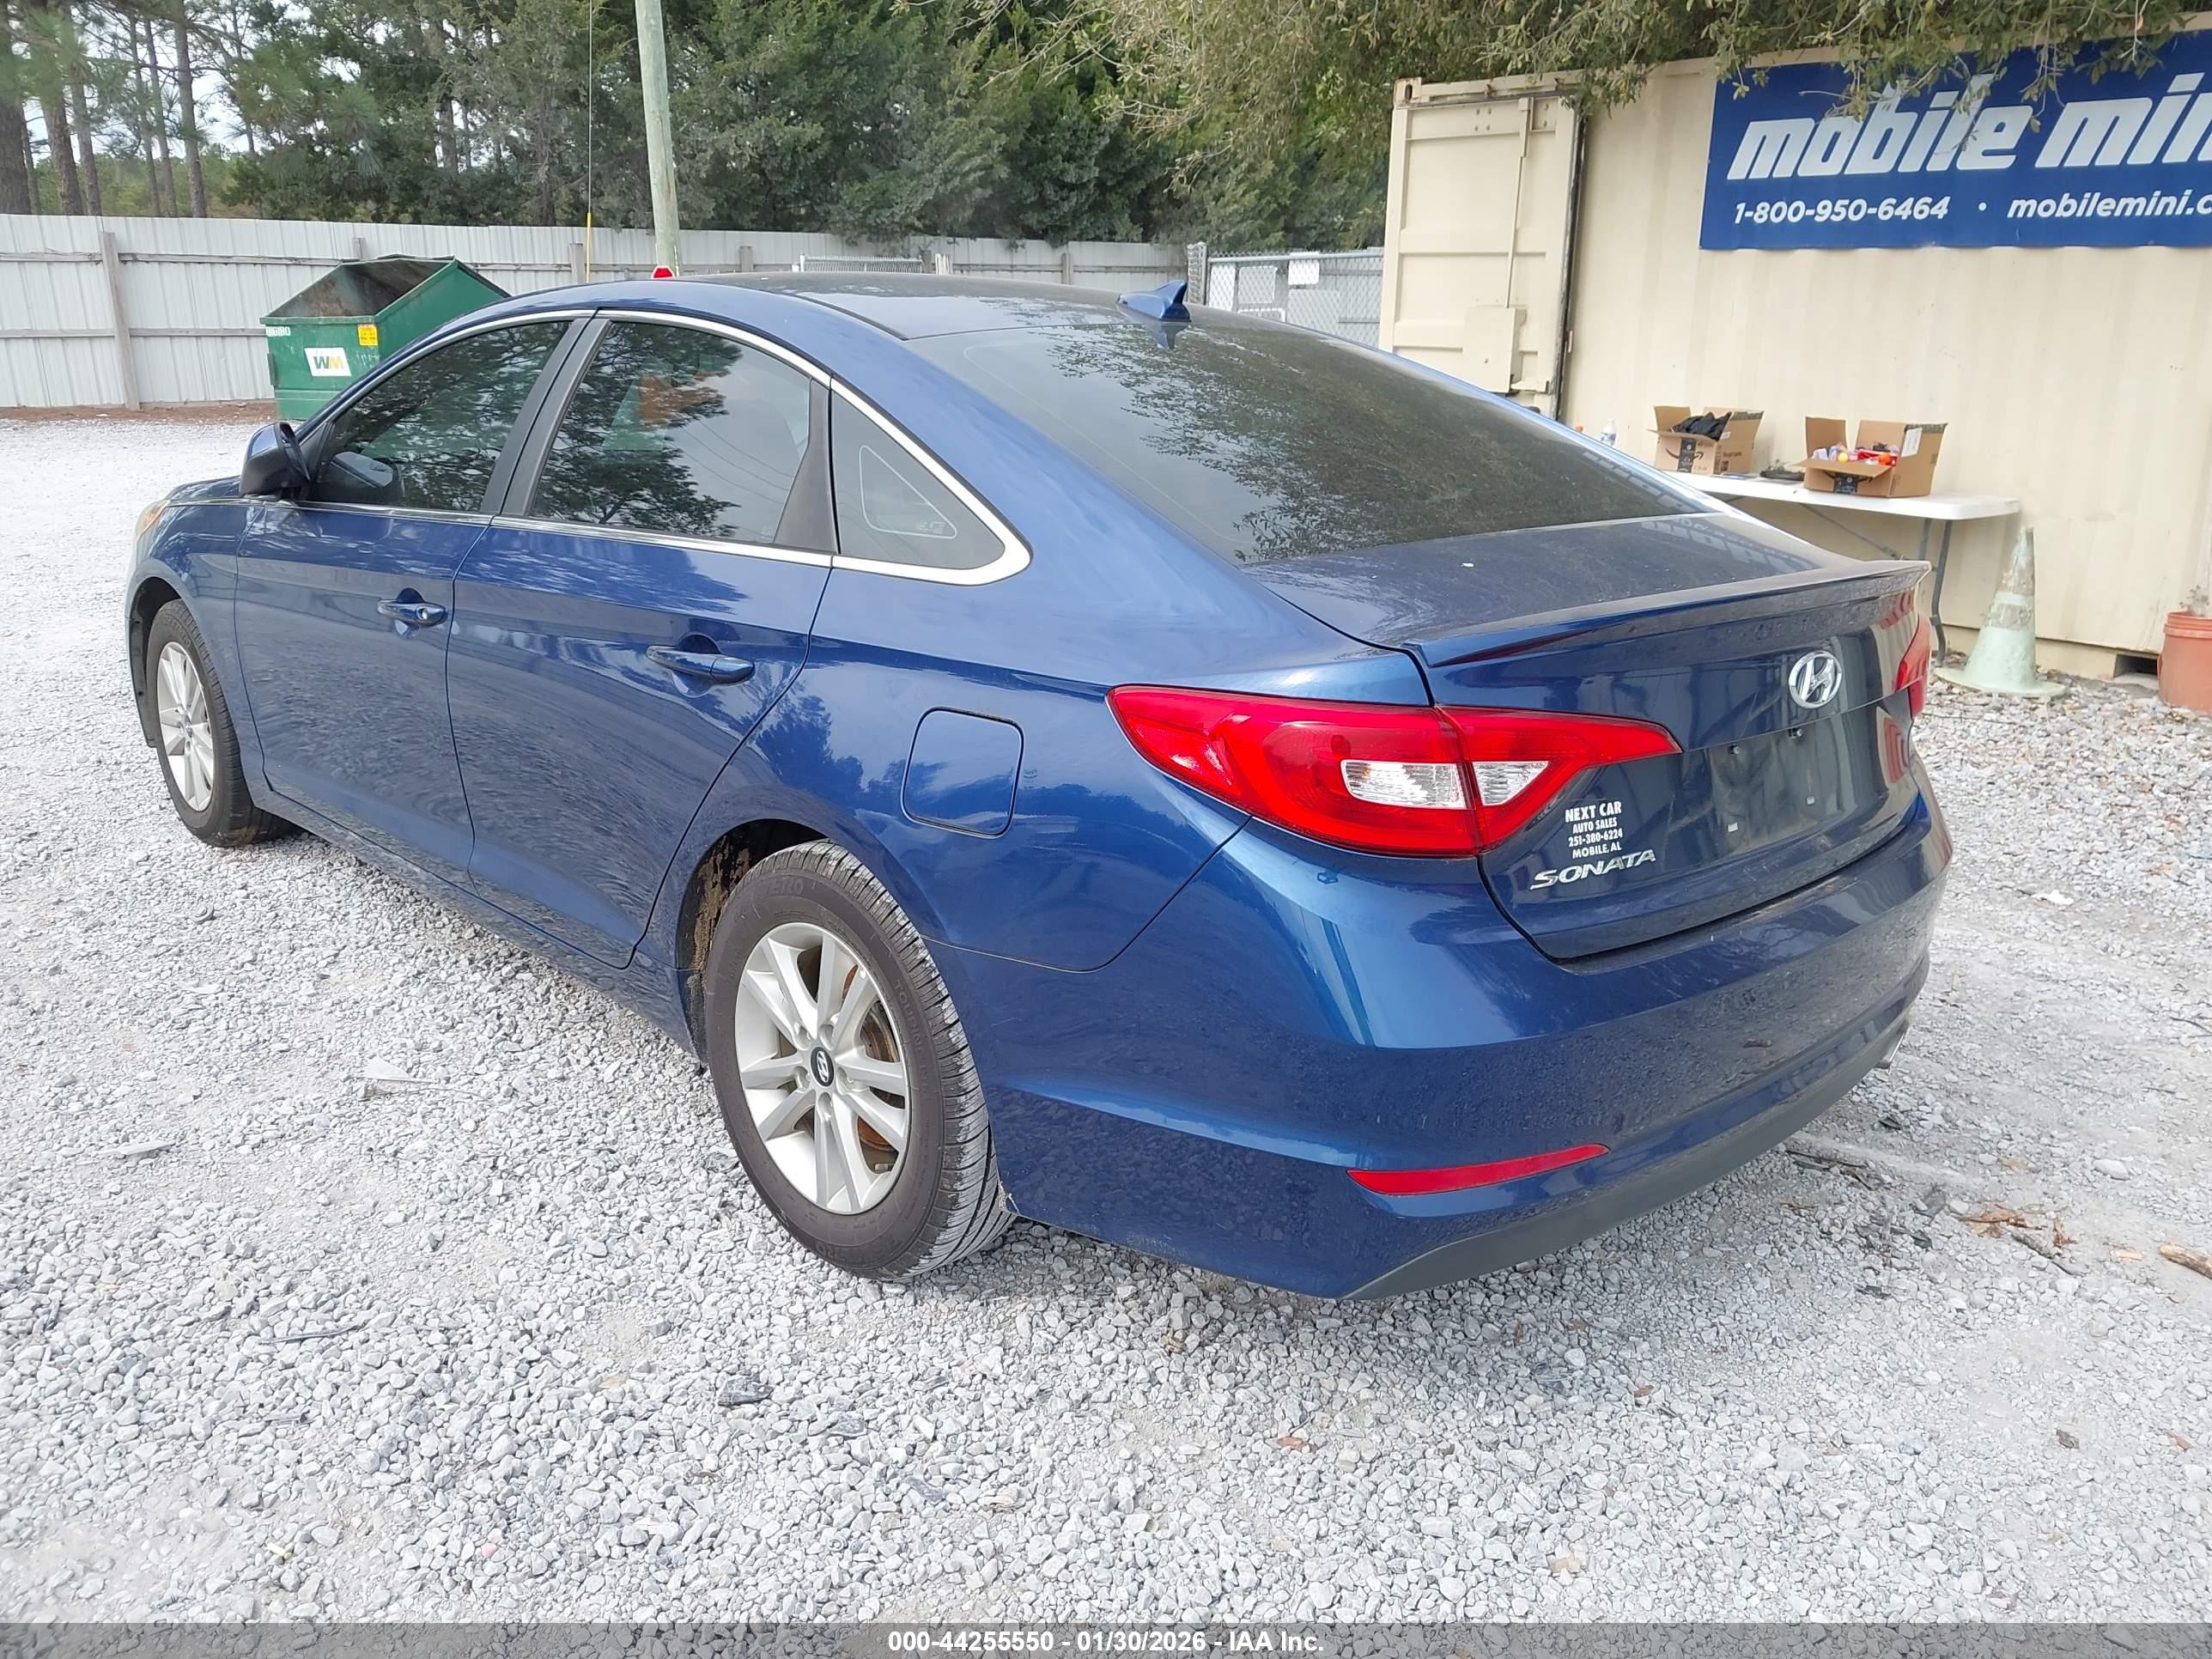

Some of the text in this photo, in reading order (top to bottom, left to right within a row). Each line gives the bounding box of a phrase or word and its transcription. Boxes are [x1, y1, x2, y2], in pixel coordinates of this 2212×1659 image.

[1726, 75, 2033, 179] mobile
[1734, 196, 1951, 225] 1-800-950-6464
[313, 356, 343, 369] WM
[1565, 800, 1622, 823] NEXT CAR
[1572, 817, 1618, 835] AUTO SALES
[1568, 827, 1624, 848] 251-380-6224
[1572, 841, 1622, 860] MOBILE, AL
[1528, 848, 1656, 890] SONATA
